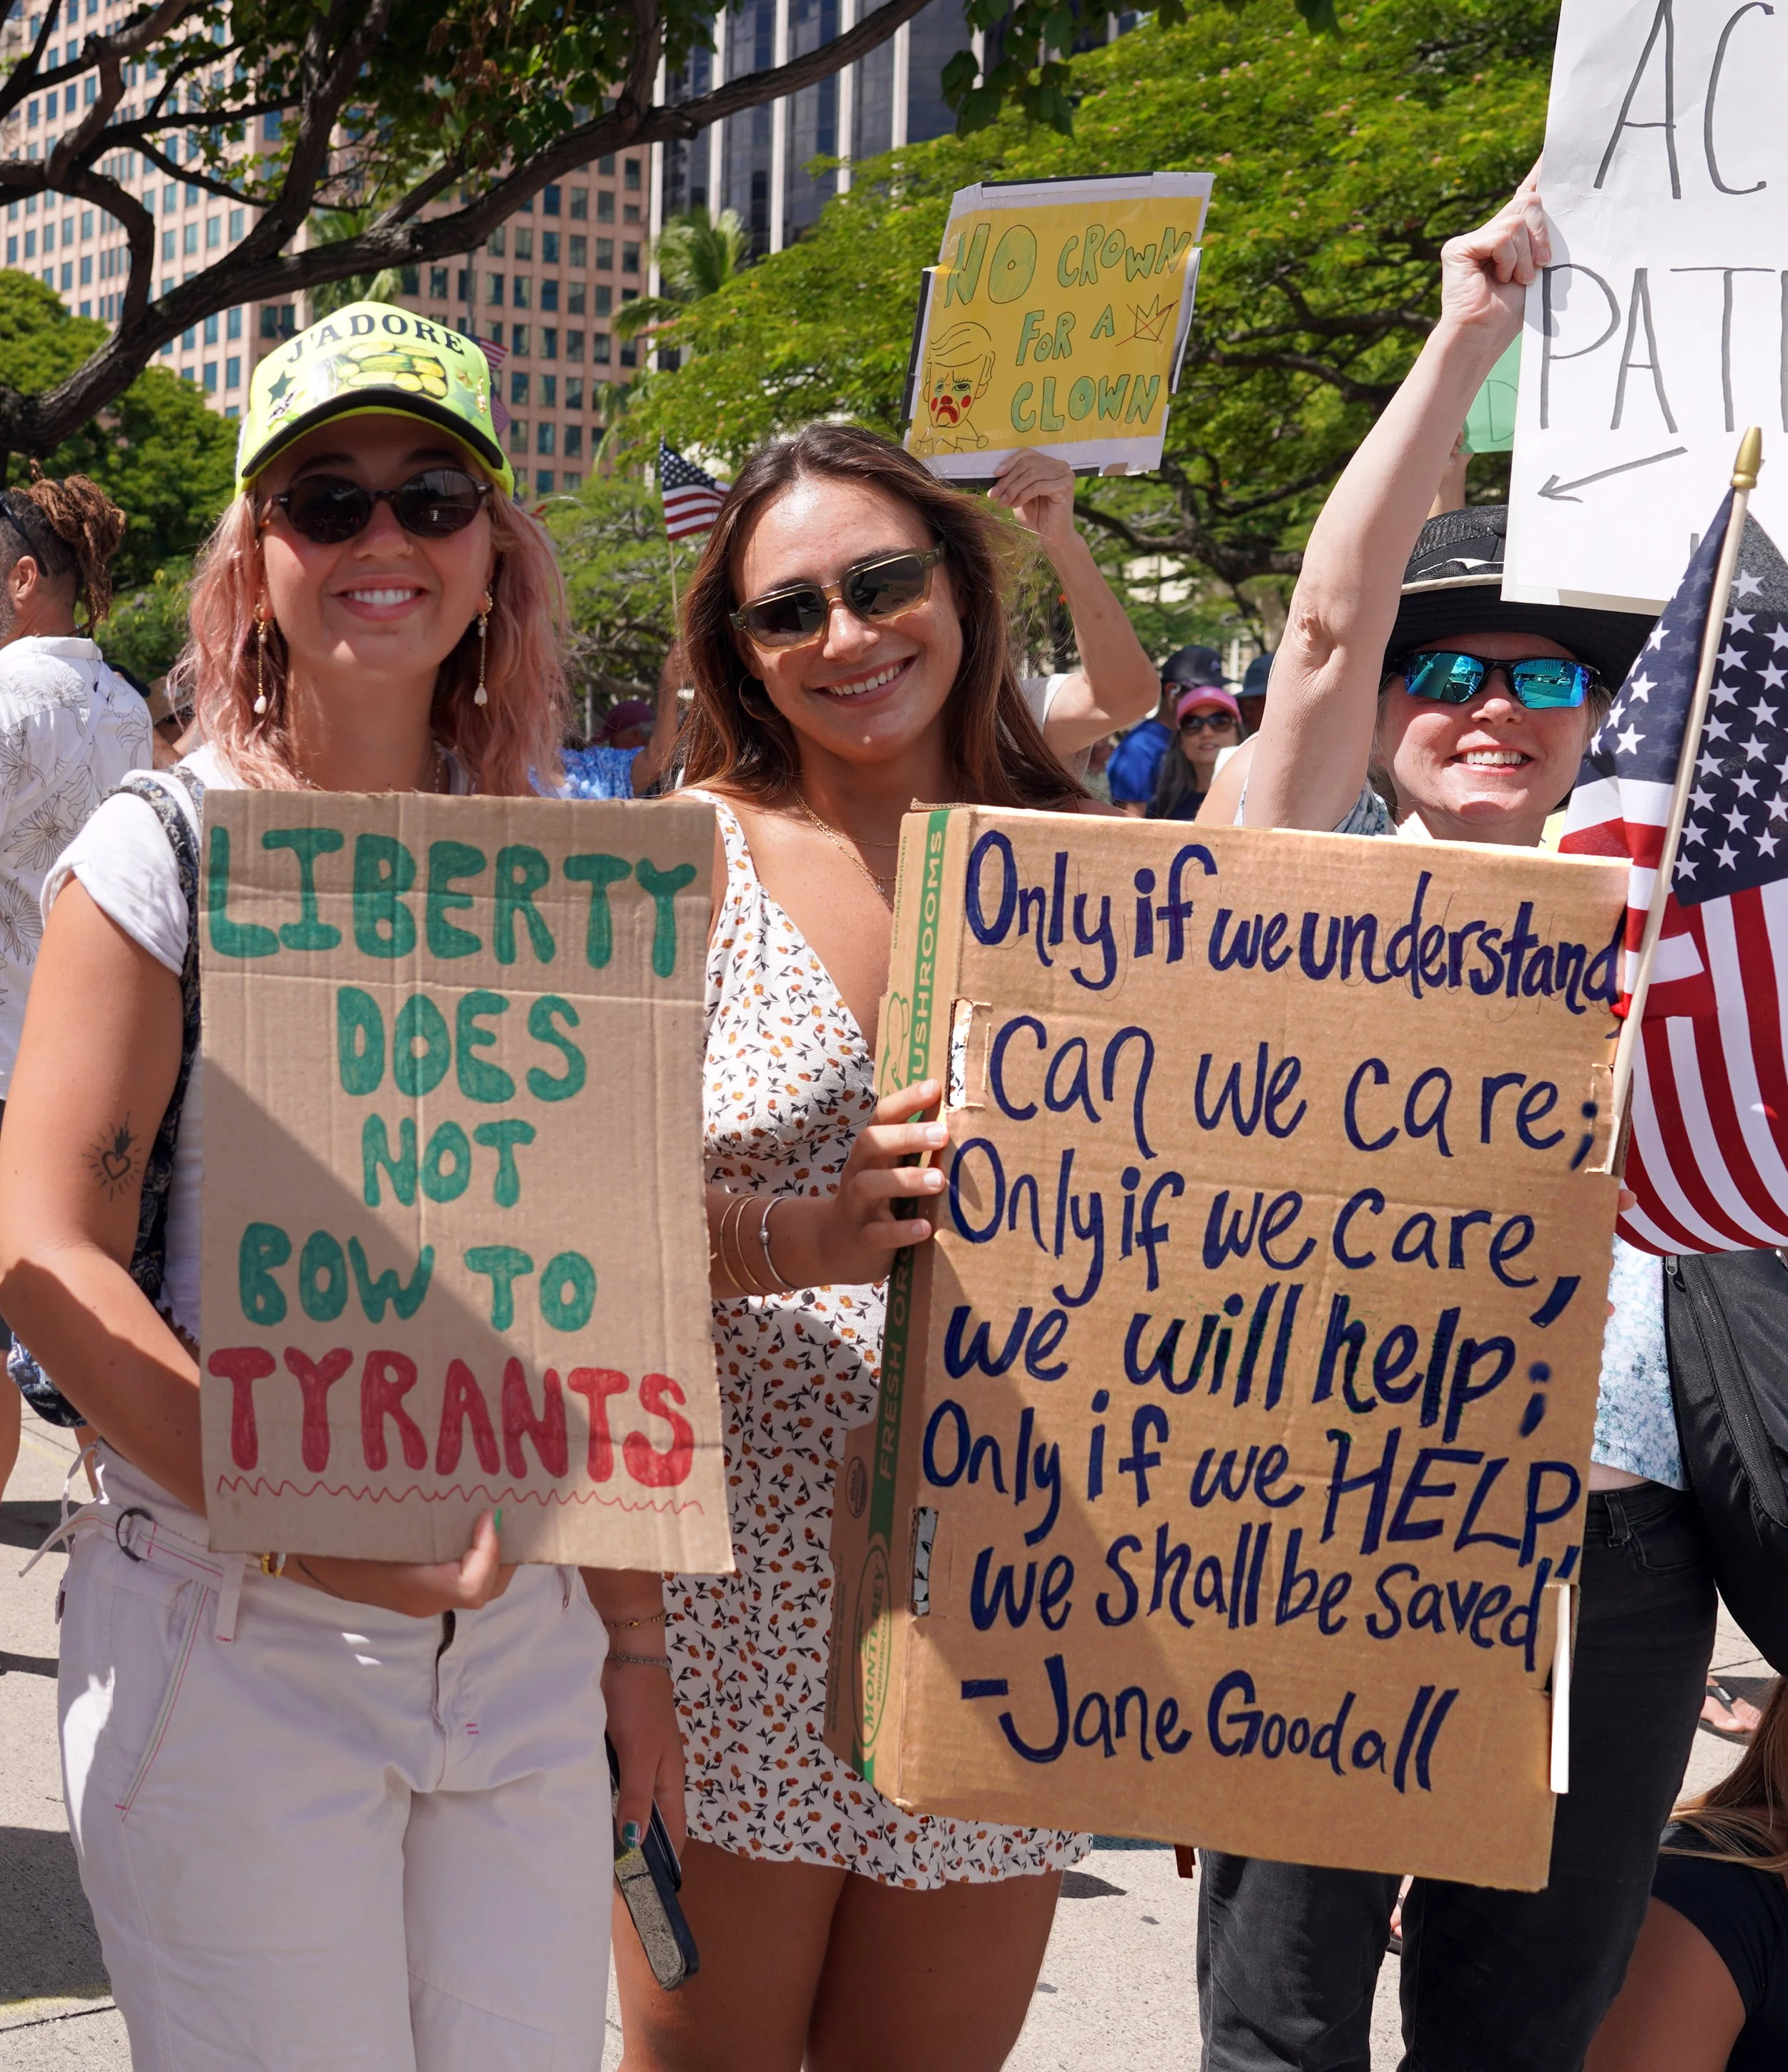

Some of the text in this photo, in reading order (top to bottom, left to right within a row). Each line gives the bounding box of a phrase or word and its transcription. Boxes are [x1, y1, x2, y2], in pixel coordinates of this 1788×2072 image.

[1593, 0, 1774, 200] AC
[944, 223, 1192, 308] NO CROWN
[287, 314, 464, 363] J'ADORE
[1011, 375, 1160, 433] CLOWN
[1016, 304, 1114, 366] FOR A
[1541, 263, 1788, 434] PAT
[208, 825, 697, 978] LIBERTY
[966, 830, 1118, 991] Only
[1134, 844, 1217, 963] if
[1208, 908, 1293, 972] we
[336, 986, 587, 1103] DOES
[362, 1113, 536, 1207] NOT
[949, 1137, 1104, 1307] Only
[1119, 1167, 1185, 1292] if
[1203, 1189, 1317, 1270] we
[238, 1222, 597, 1332] BOW TO
[207, 1346, 694, 1488] TYRANTS
[880, 1342, 903, 1480] FRESH
[943, 1281, 1551, 1445] we will help;
[922, 1400, 1061, 1546] Only
[1088, 1390, 1171, 1507] if
[1190, 1444, 1305, 1508] we
[863, 1562, 885, 1730] MONTEREY
[970, 1546, 1074, 1631] we
[1276, 1528, 1352, 1636] be
[1208, 1669, 1459, 1794] Goodall
